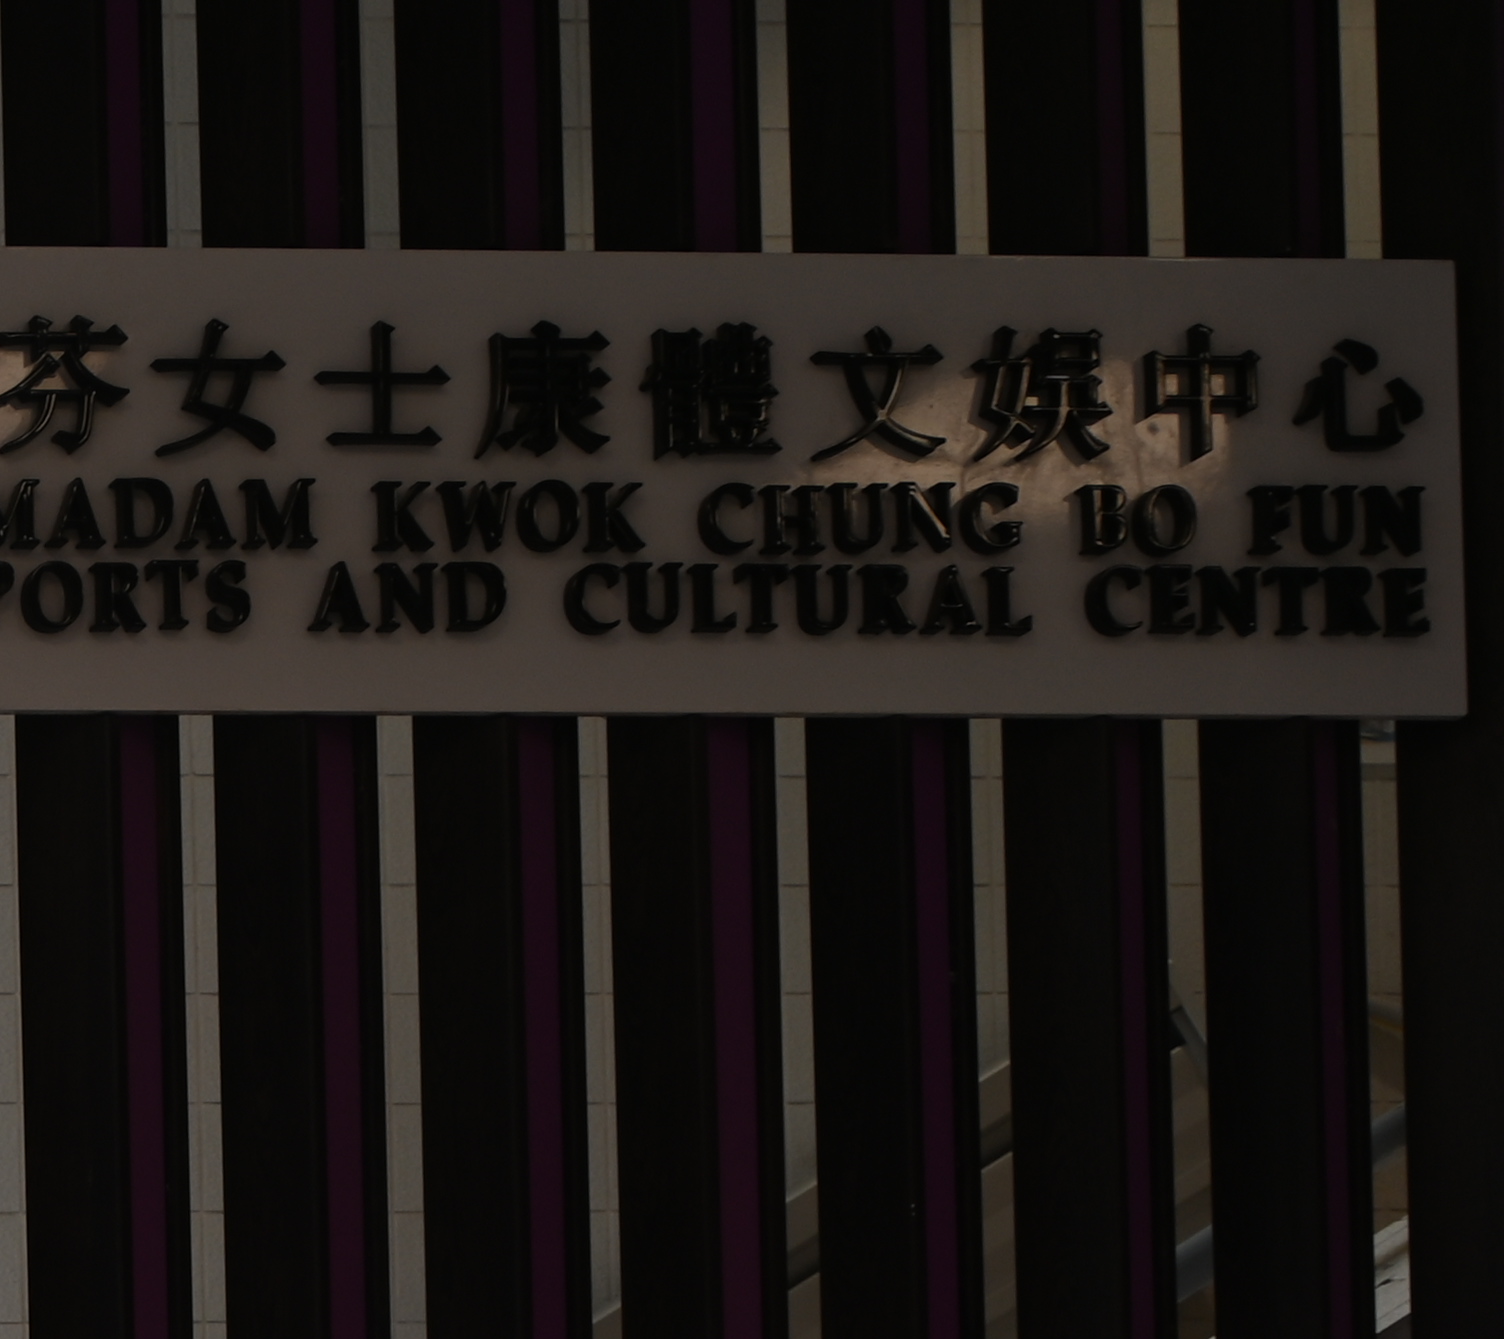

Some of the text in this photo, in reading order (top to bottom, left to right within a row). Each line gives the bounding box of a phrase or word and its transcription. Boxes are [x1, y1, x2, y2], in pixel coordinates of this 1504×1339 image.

[370, 475, 645, 554] KWOK
[697, 482, 1025, 556] CHUNG
[1077, 483, 1199, 557] BO
[1245, 485, 1426, 557] FUN
[307, 561, 507, 635] AND
[562, 562, 1033, 637] CULTURAL
[1083, 565, 1431, 640] CENTRE
